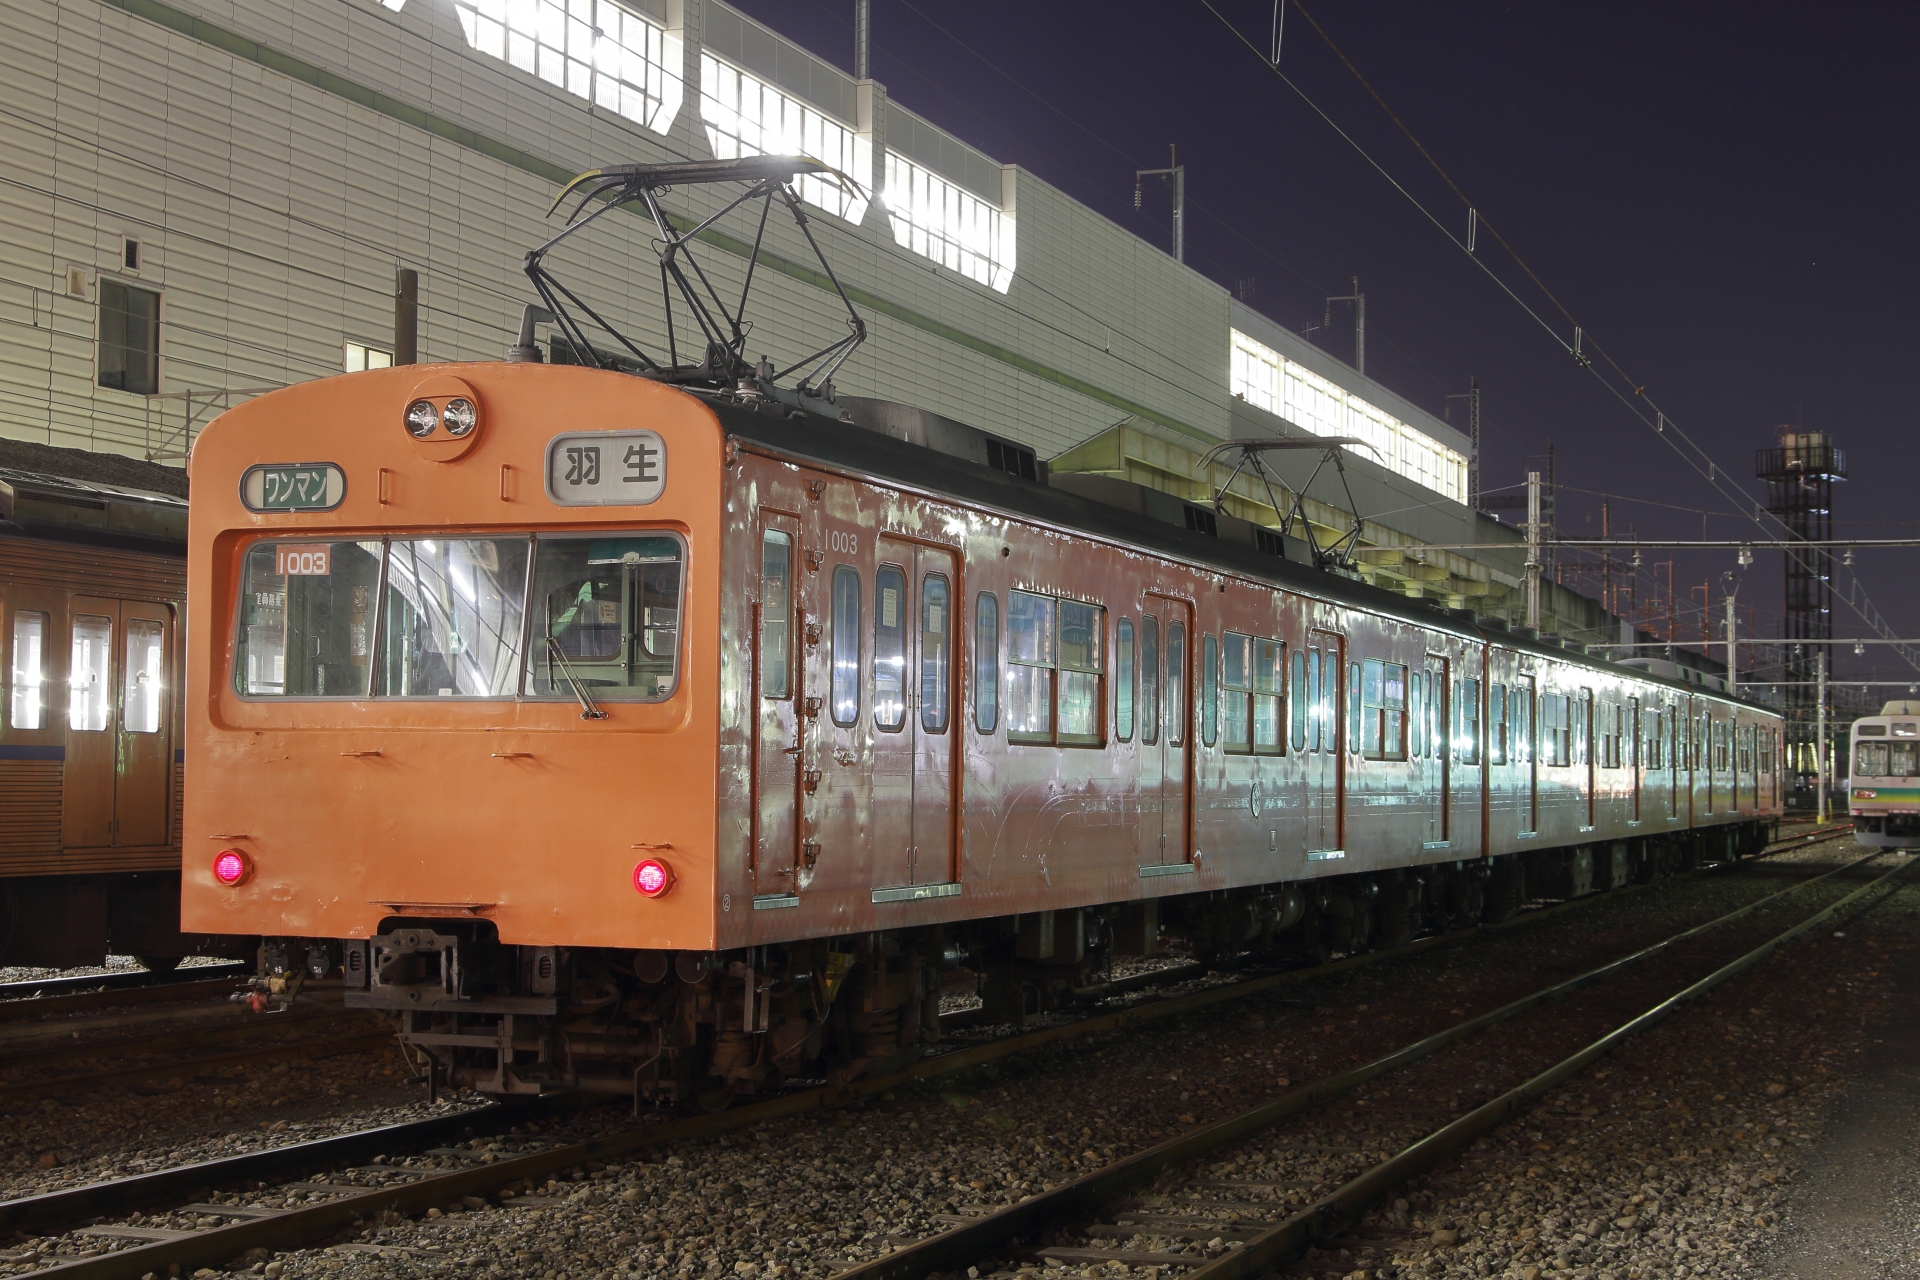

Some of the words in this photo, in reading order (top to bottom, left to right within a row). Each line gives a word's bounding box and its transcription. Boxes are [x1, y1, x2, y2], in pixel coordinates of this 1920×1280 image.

[564, 443, 659, 486] 羽生
[265, 471, 327, 503] ワンマン
[825, 528, 858, 555] 1003
[279, 552, 326, 574] 1003
